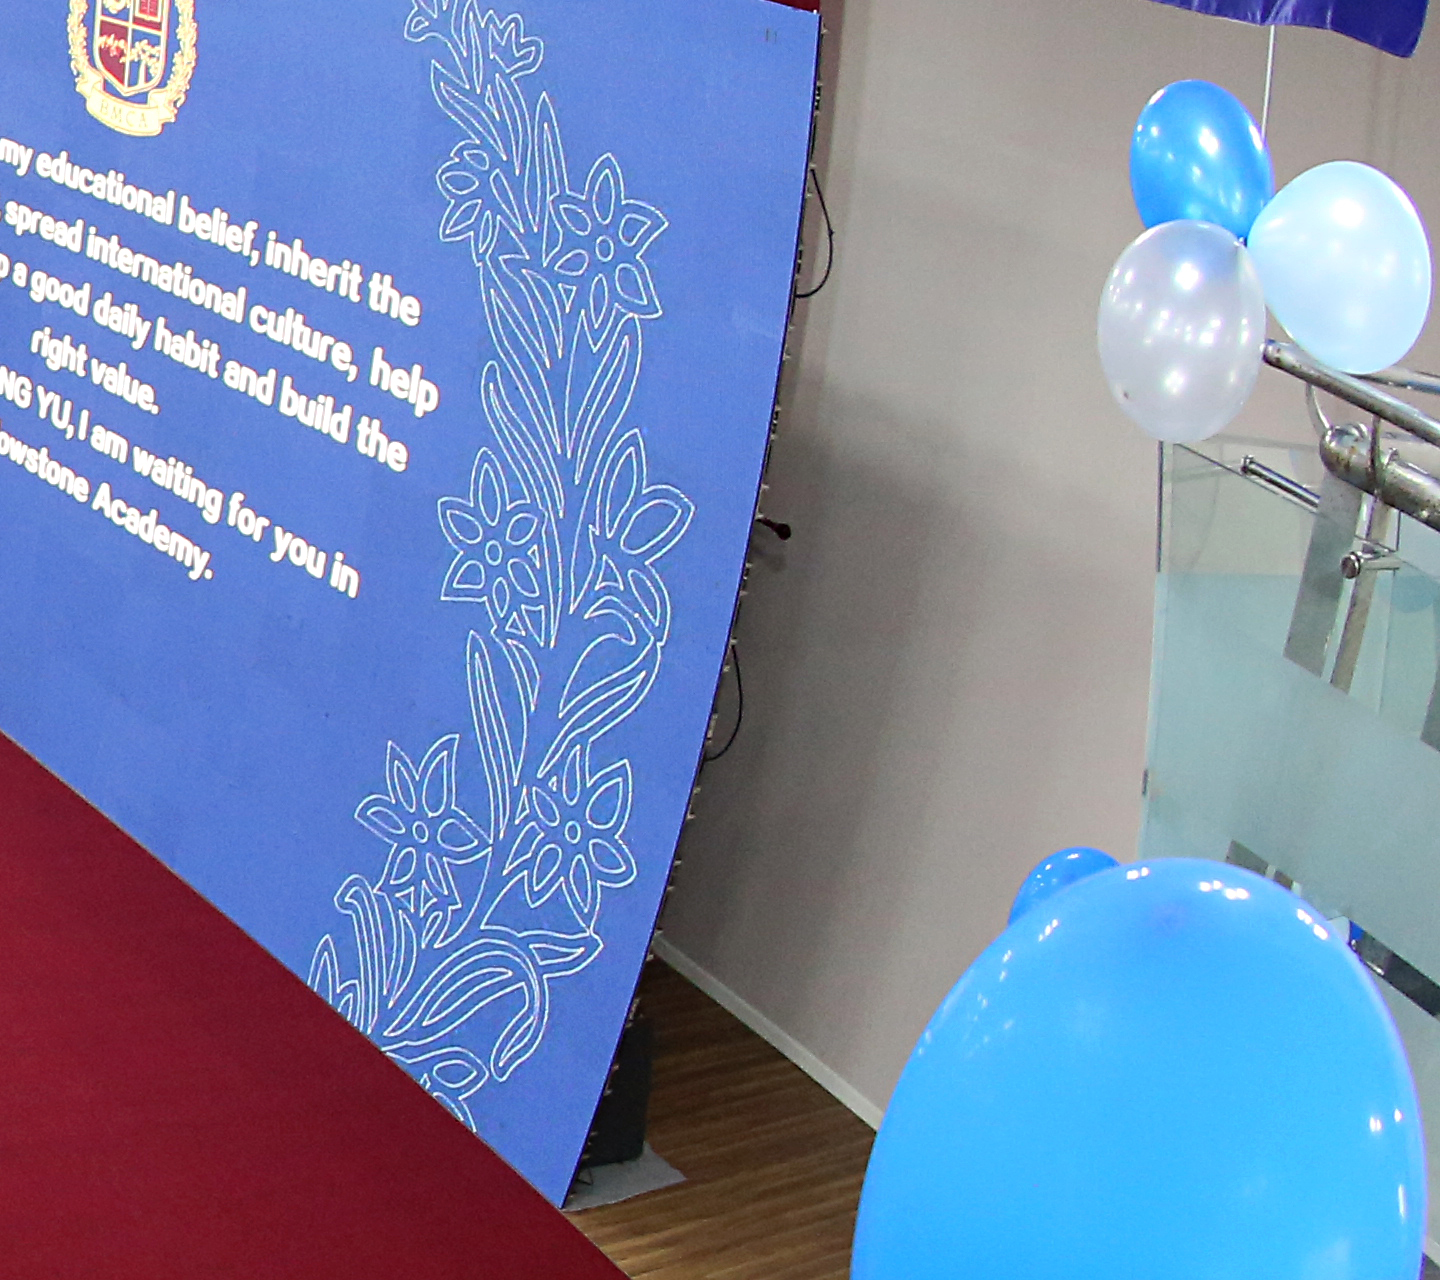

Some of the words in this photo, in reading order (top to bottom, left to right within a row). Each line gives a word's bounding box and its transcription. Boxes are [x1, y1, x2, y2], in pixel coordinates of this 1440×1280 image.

[100, 99, 148, 128] BMCA
[4, 200, 85, 253] spread
[85, 225, 247, 324] international
[249, 304, 358, 383] culture,
[369, 346, 439, 418] help
[35, 150, 176, 226] educational
[177, 195, 260, 267] belief,
[264, 230, 364, 303] inherit
[368, 271, 421, 327] the
[12, 262, 28, 288] a
[29, 270, 91, 317] good
[92, 291, 152, 350] daily
[154, 316, 221, 379] habit
[223, 360, 277, 407] and
[278, 375, 353, 444] build
[356, 415, 409, 473] the
[30, 326, 89, 378] right
[90, 357, 159, 415] value.
[36, 385, 75, 440] YU,
[77, 409, 90, 441] I
[90, 424, 129, 464] am
[132, 446, 224, 525] waiting
[227, 491, 271, 542] for
[269, 525, 327, 579] you
[329, 551, 359, 599] in
[91, 482, 213, 581] Academy.
